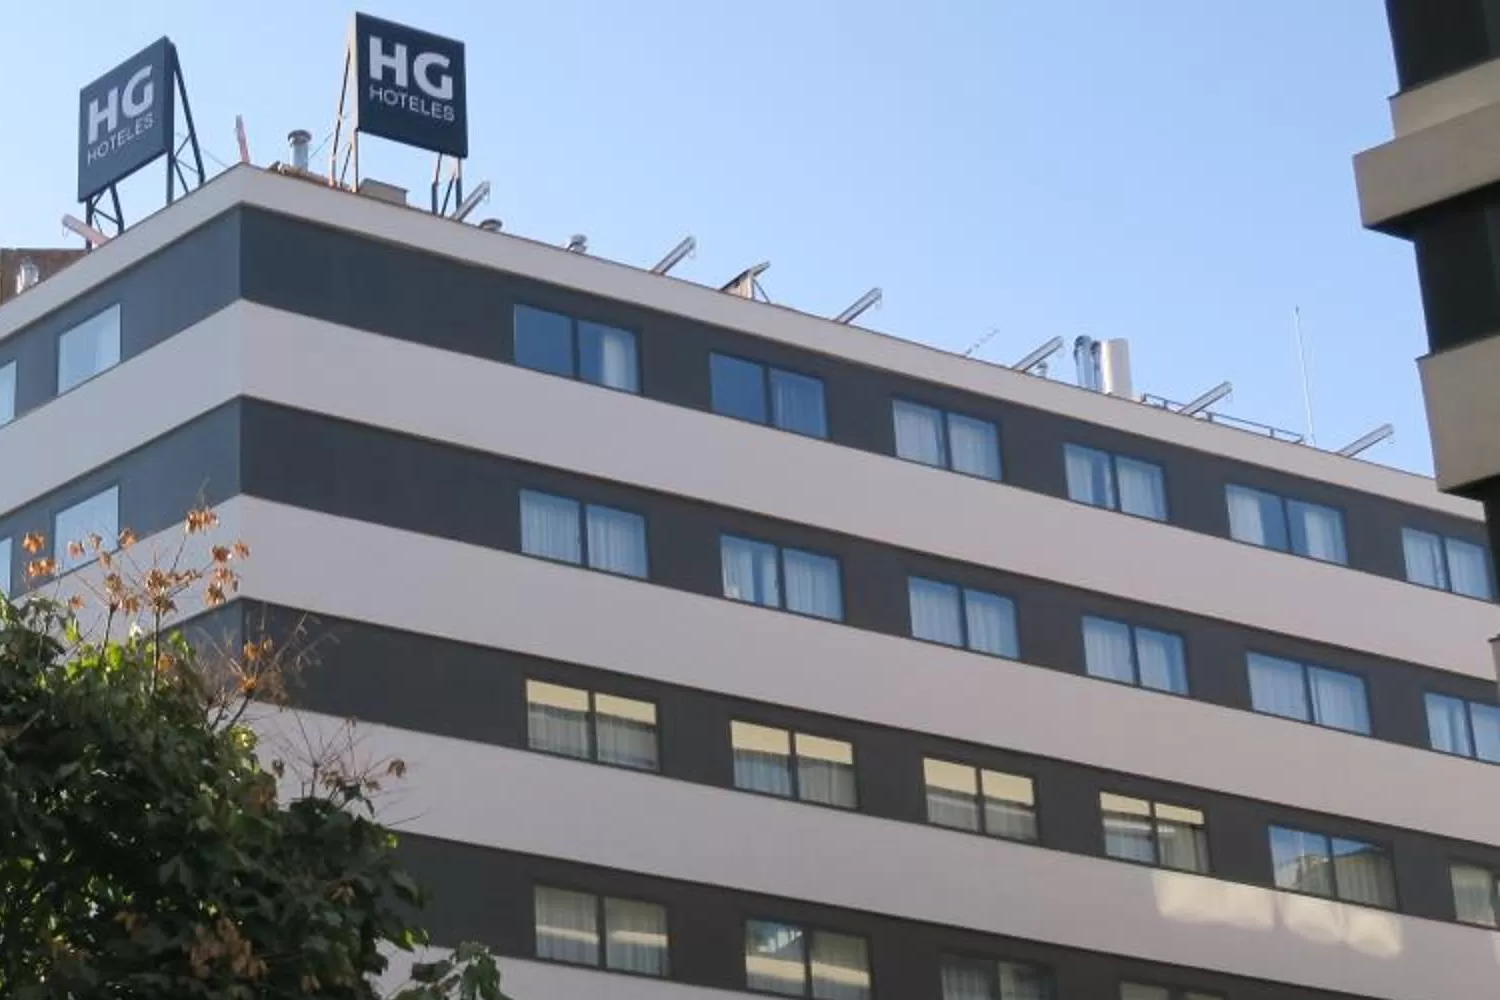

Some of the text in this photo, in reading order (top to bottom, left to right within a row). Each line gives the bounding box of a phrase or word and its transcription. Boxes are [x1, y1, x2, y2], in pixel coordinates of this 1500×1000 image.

[369, 35, 453, 100] HG
[87, 64, 154, 145] HG
[369, 84, 455, 122] HOTELES
[87, 112, 154, 166] HOTELES
